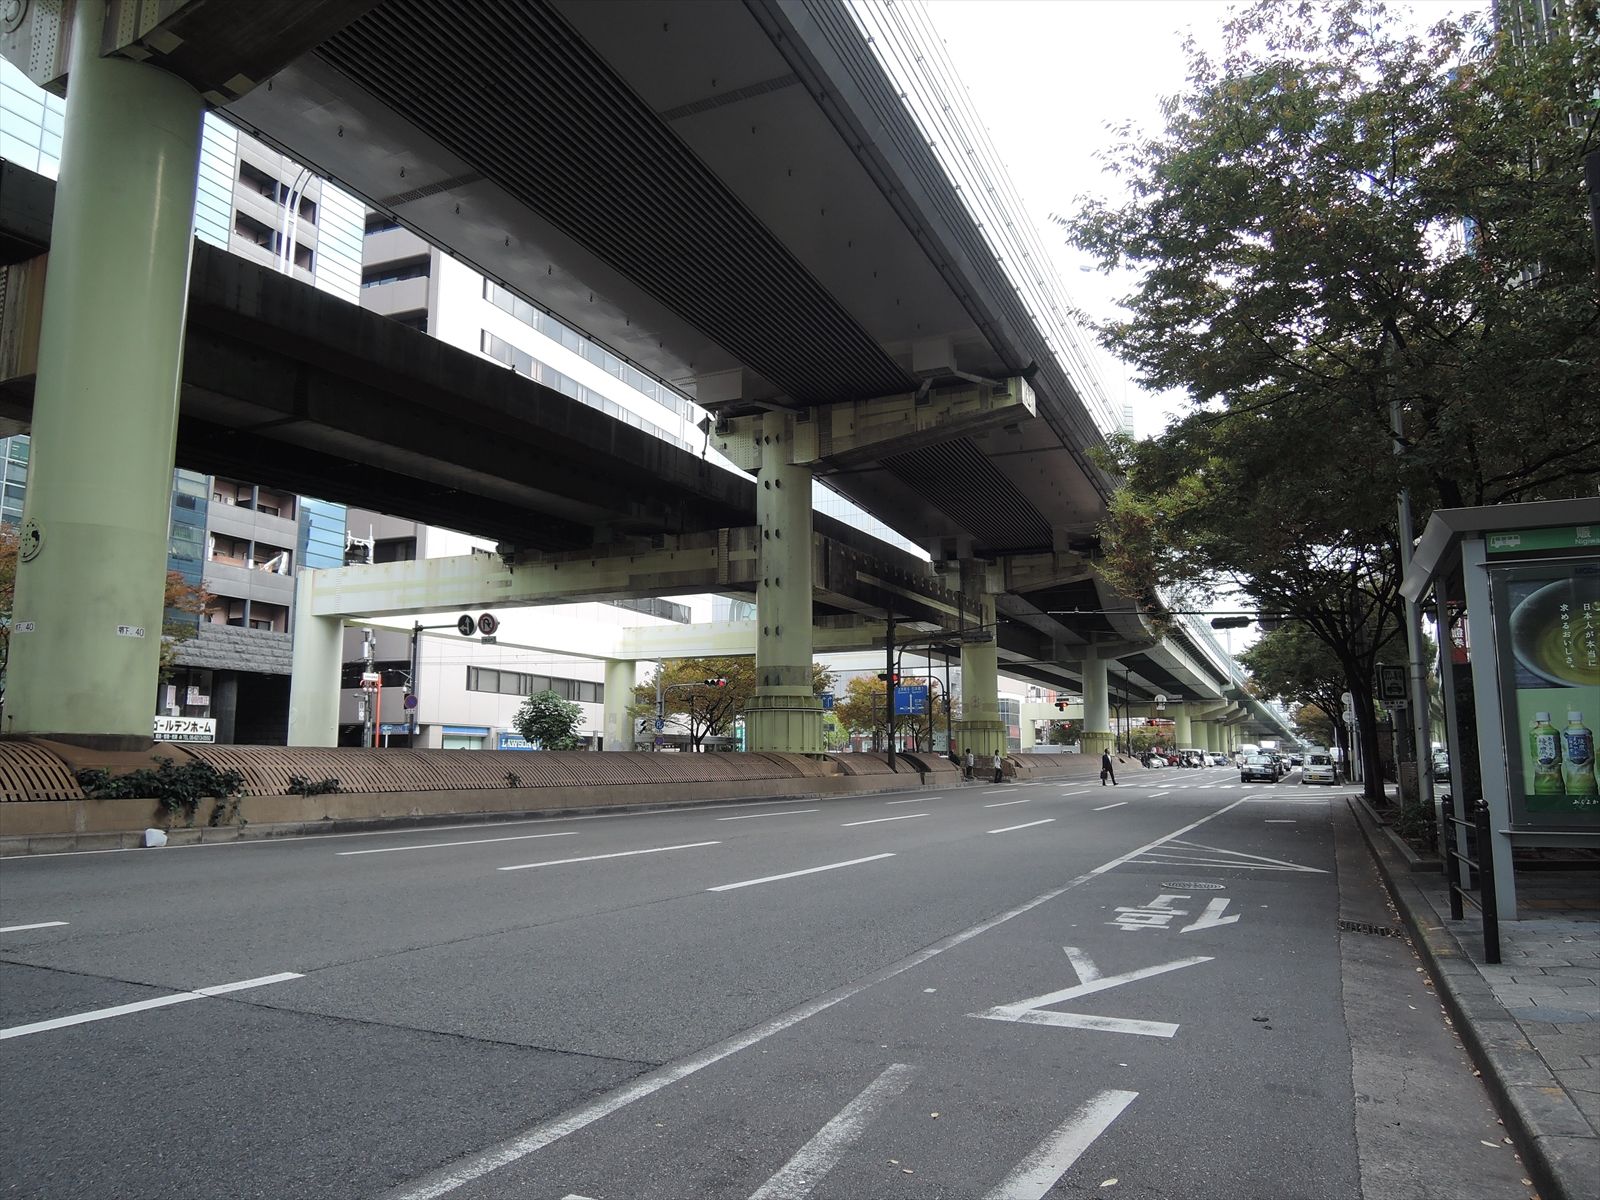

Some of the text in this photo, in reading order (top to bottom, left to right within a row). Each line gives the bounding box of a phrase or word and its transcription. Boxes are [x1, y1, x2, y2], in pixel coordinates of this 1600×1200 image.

[1560, 603, 1575, 668] 求めるおいしさ。
[1583, 603, 1597, 667] 日本人が本当に
